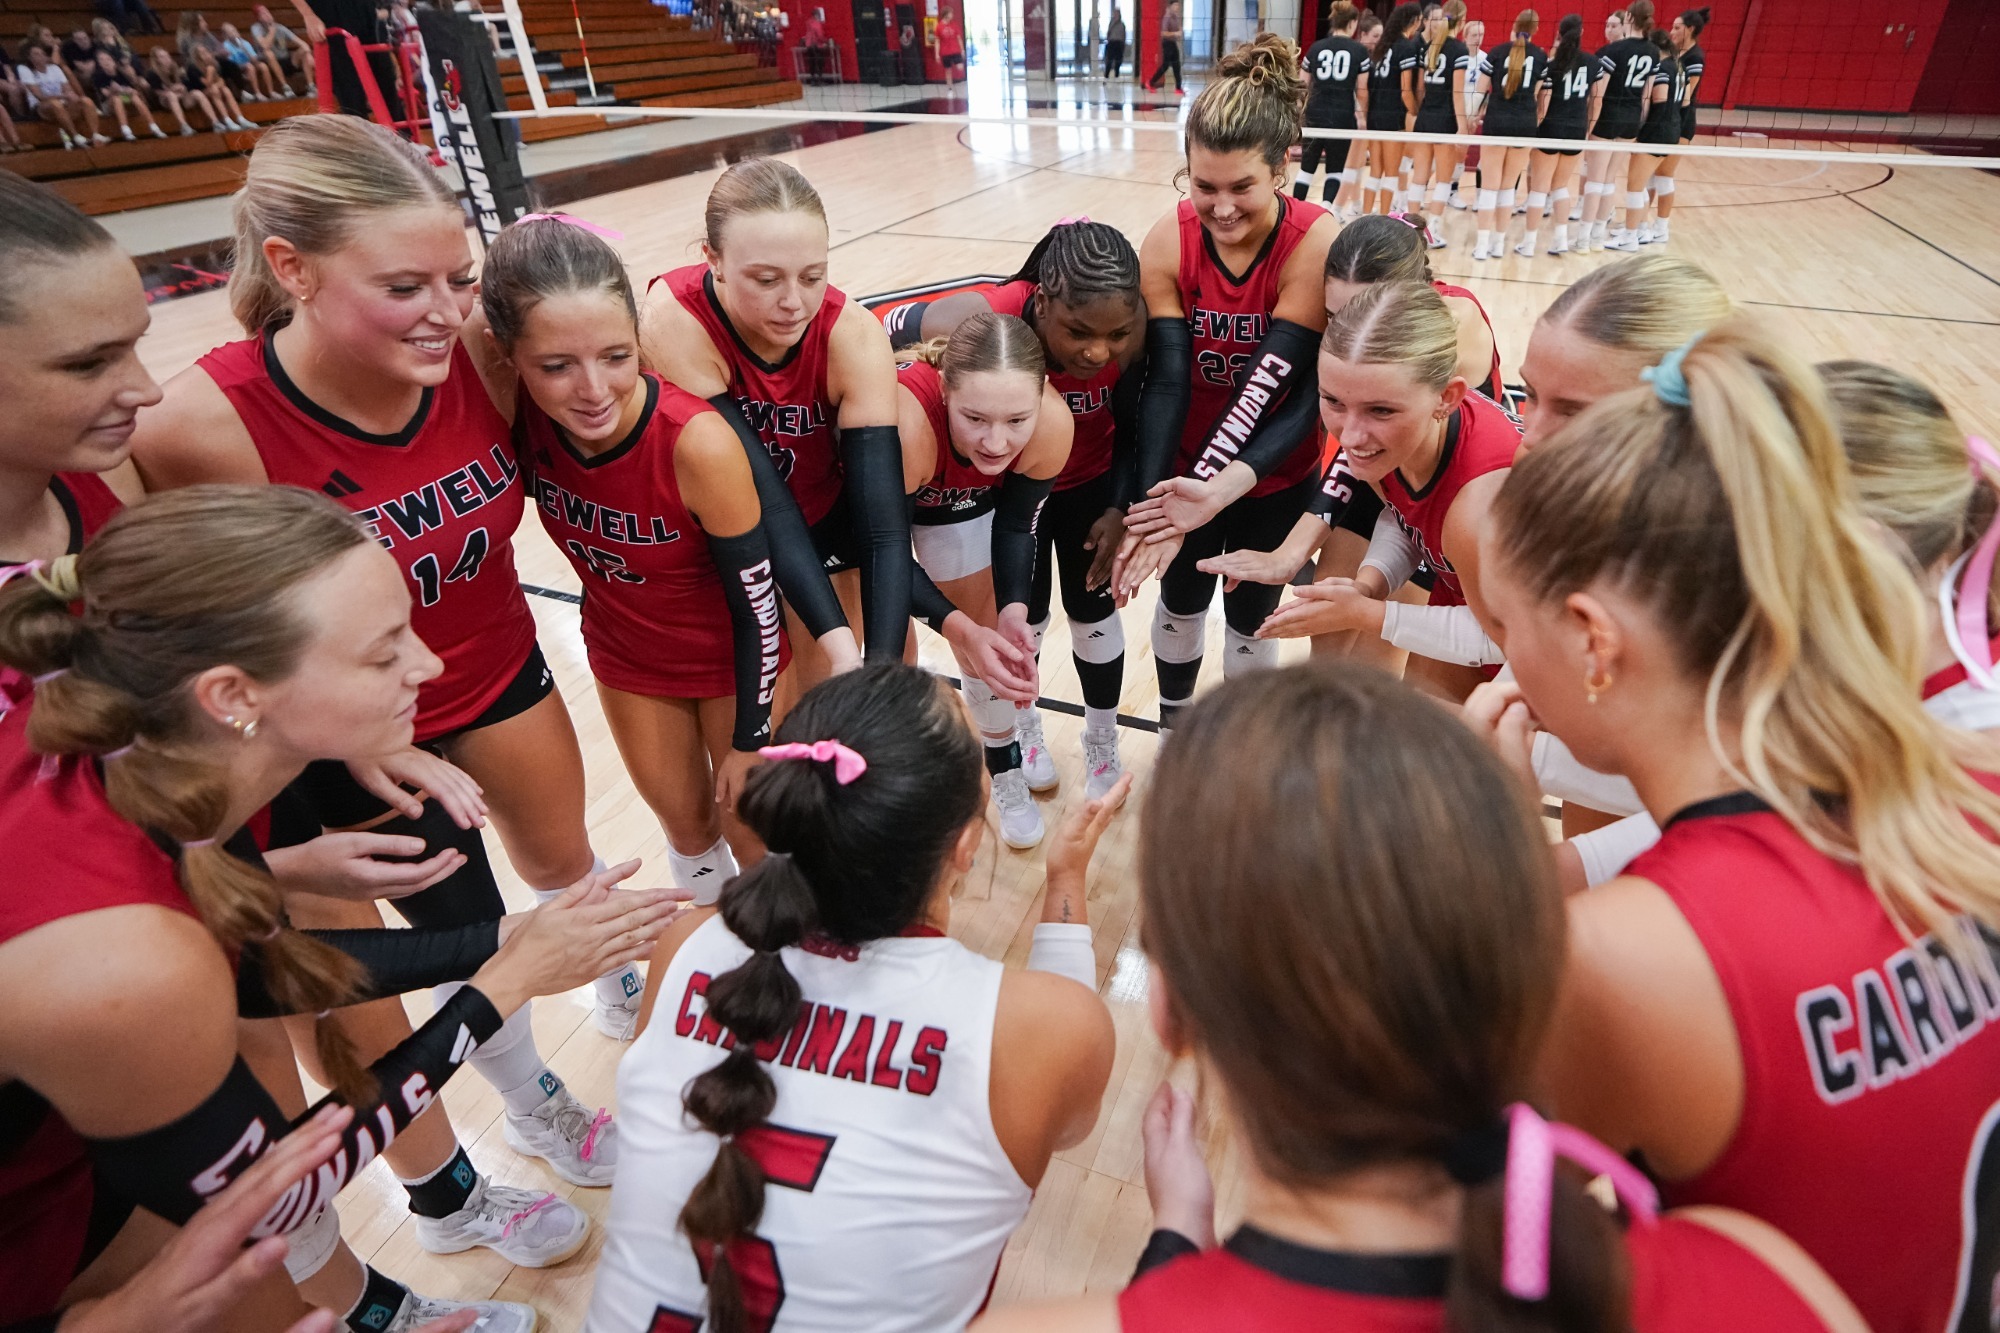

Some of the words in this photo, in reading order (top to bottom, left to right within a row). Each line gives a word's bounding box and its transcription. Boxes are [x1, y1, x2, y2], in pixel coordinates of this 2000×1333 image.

[1316, 49, 1351, 81] 30
[1469, 70, 1477, 83] 2
[1562, 66, 1589, 100] 14
[1624, 54, 1653, 88] 12
[1194, 353, 1292, 482] CARDINALS
[410, 527, 489, 608] 14
[566, 539, 647, 584] 15
[739, 558, 781, 705] CARDINALS
